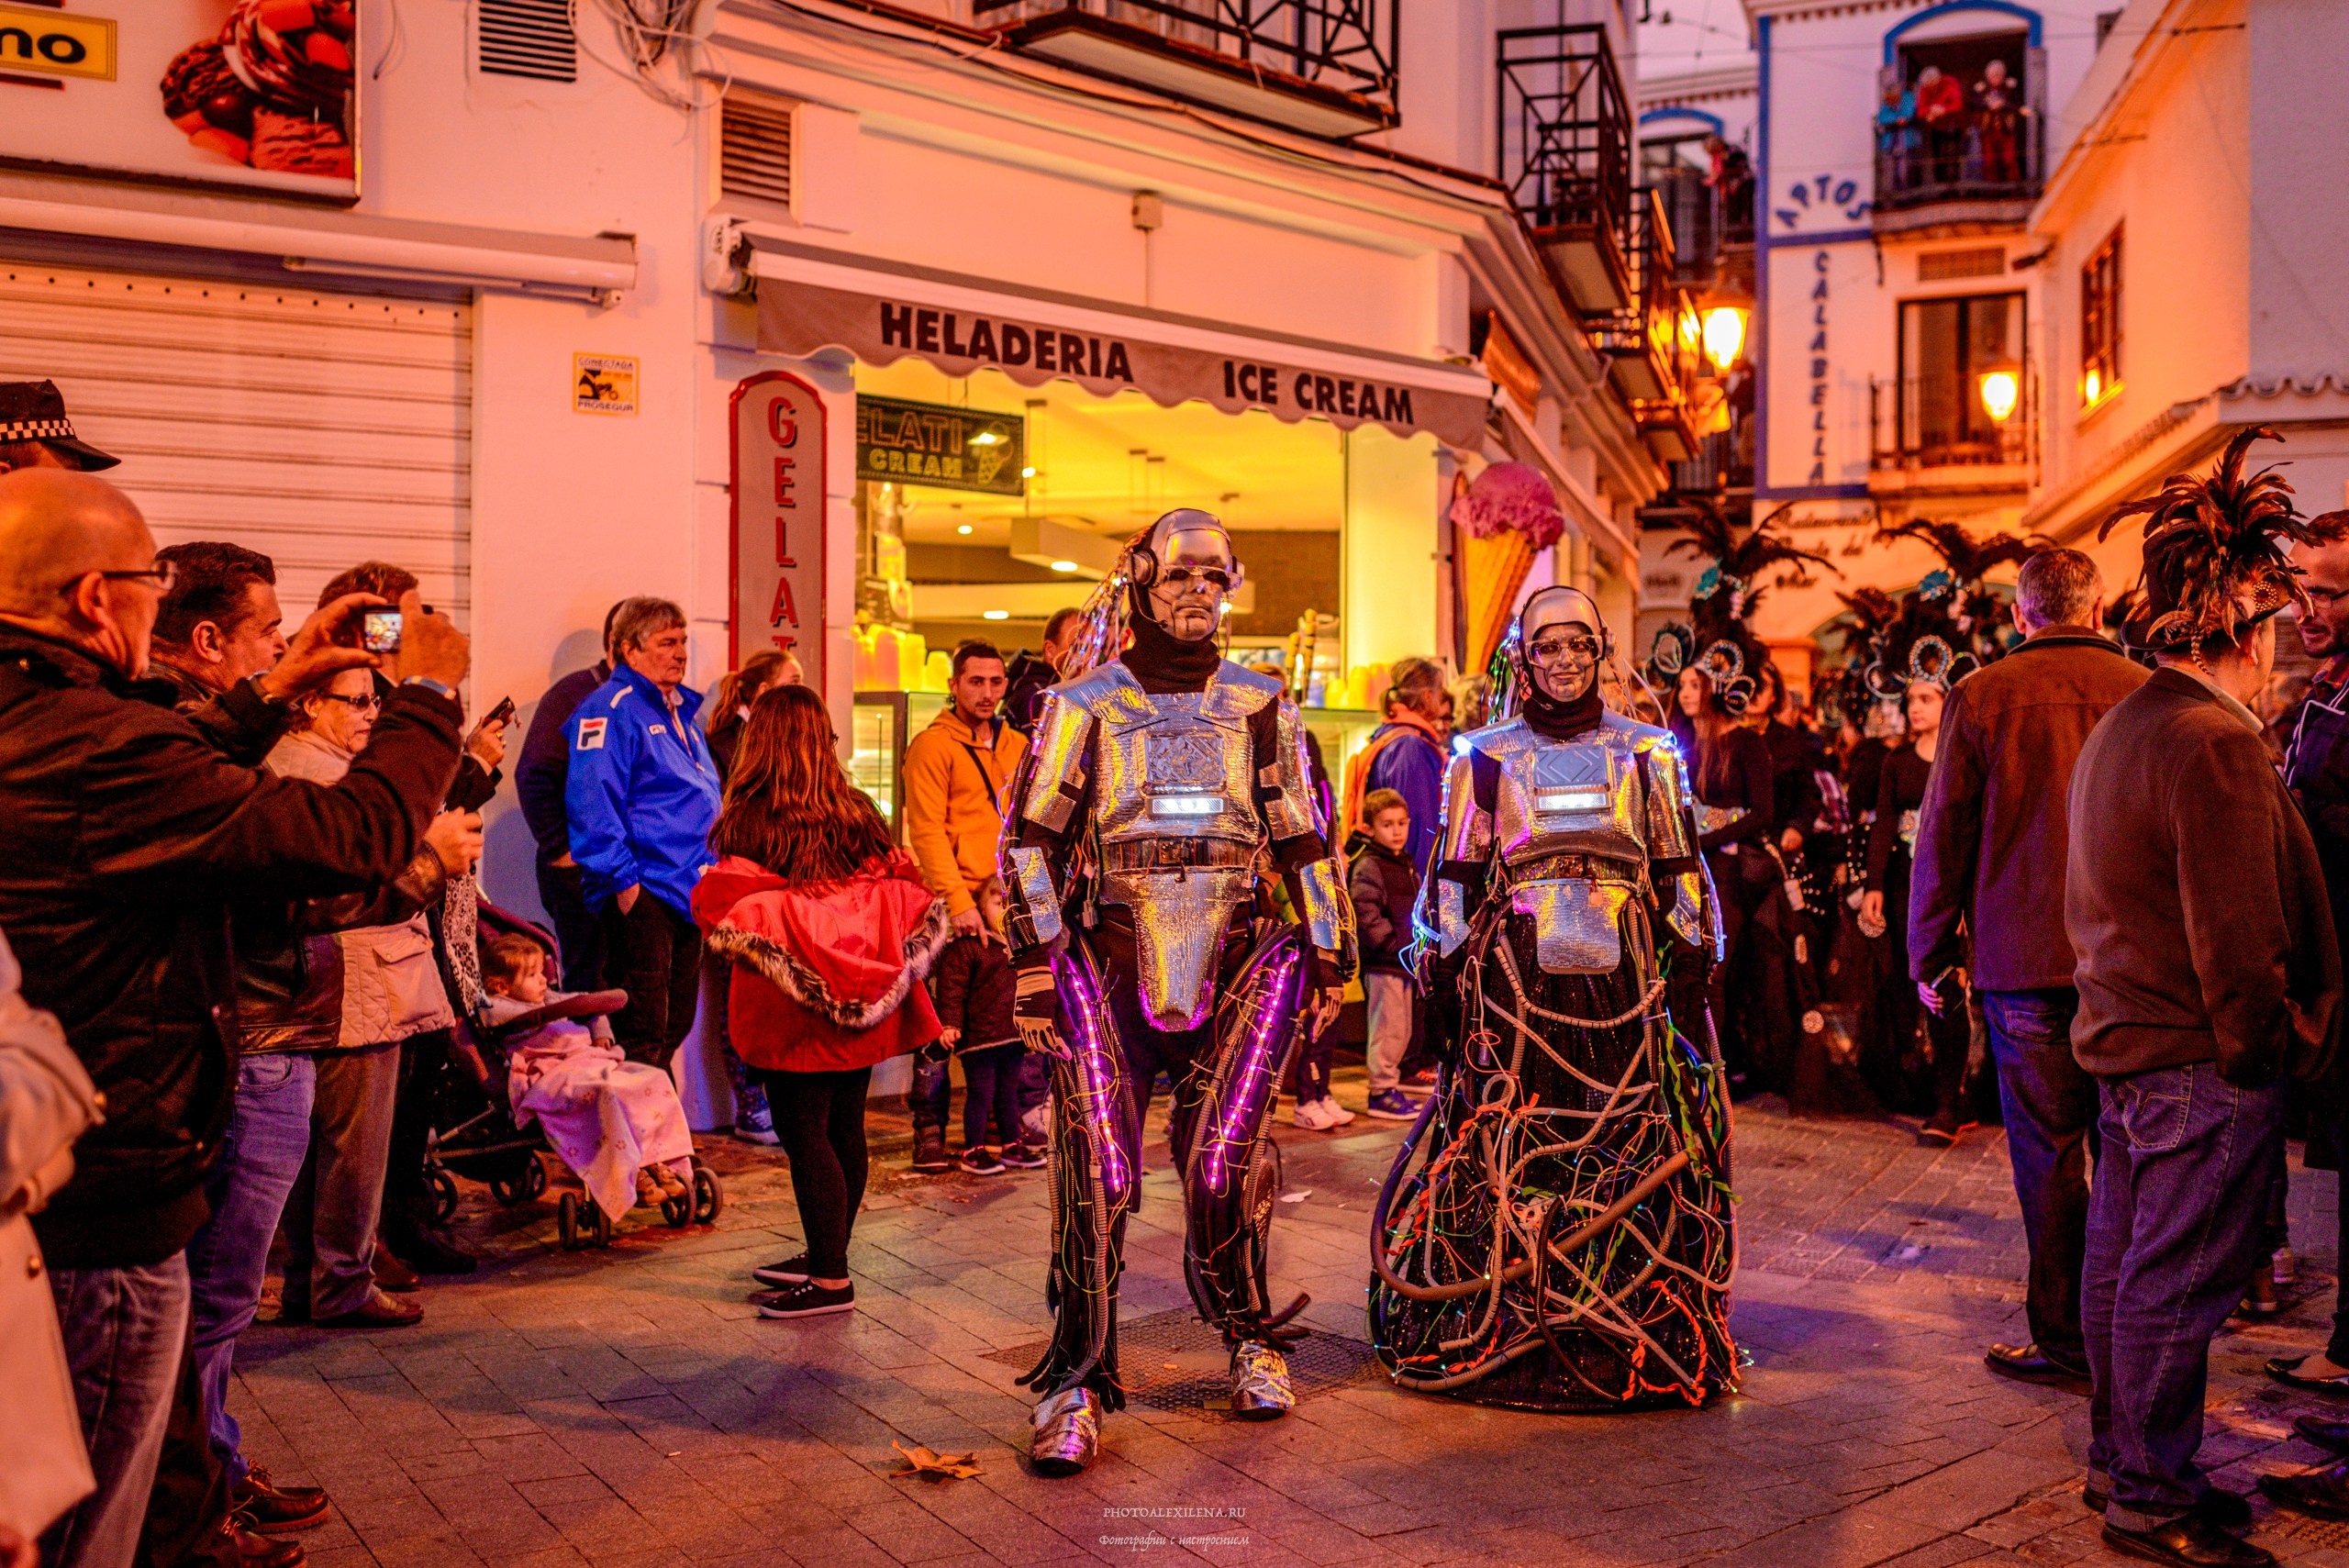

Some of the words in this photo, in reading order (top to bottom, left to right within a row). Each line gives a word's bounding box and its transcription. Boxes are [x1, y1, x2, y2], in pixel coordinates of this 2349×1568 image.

[1775, 174, 1874, 228] APTOS
[880, 302, 1135, 384] HELADERIA
[1809, 250, 1831, 485] CALABELLA
[1224, 361, 1278, 405] ICE
[1294, 373, 1414, 425] CREAM
[869, 448, 963, 479] CREAM
